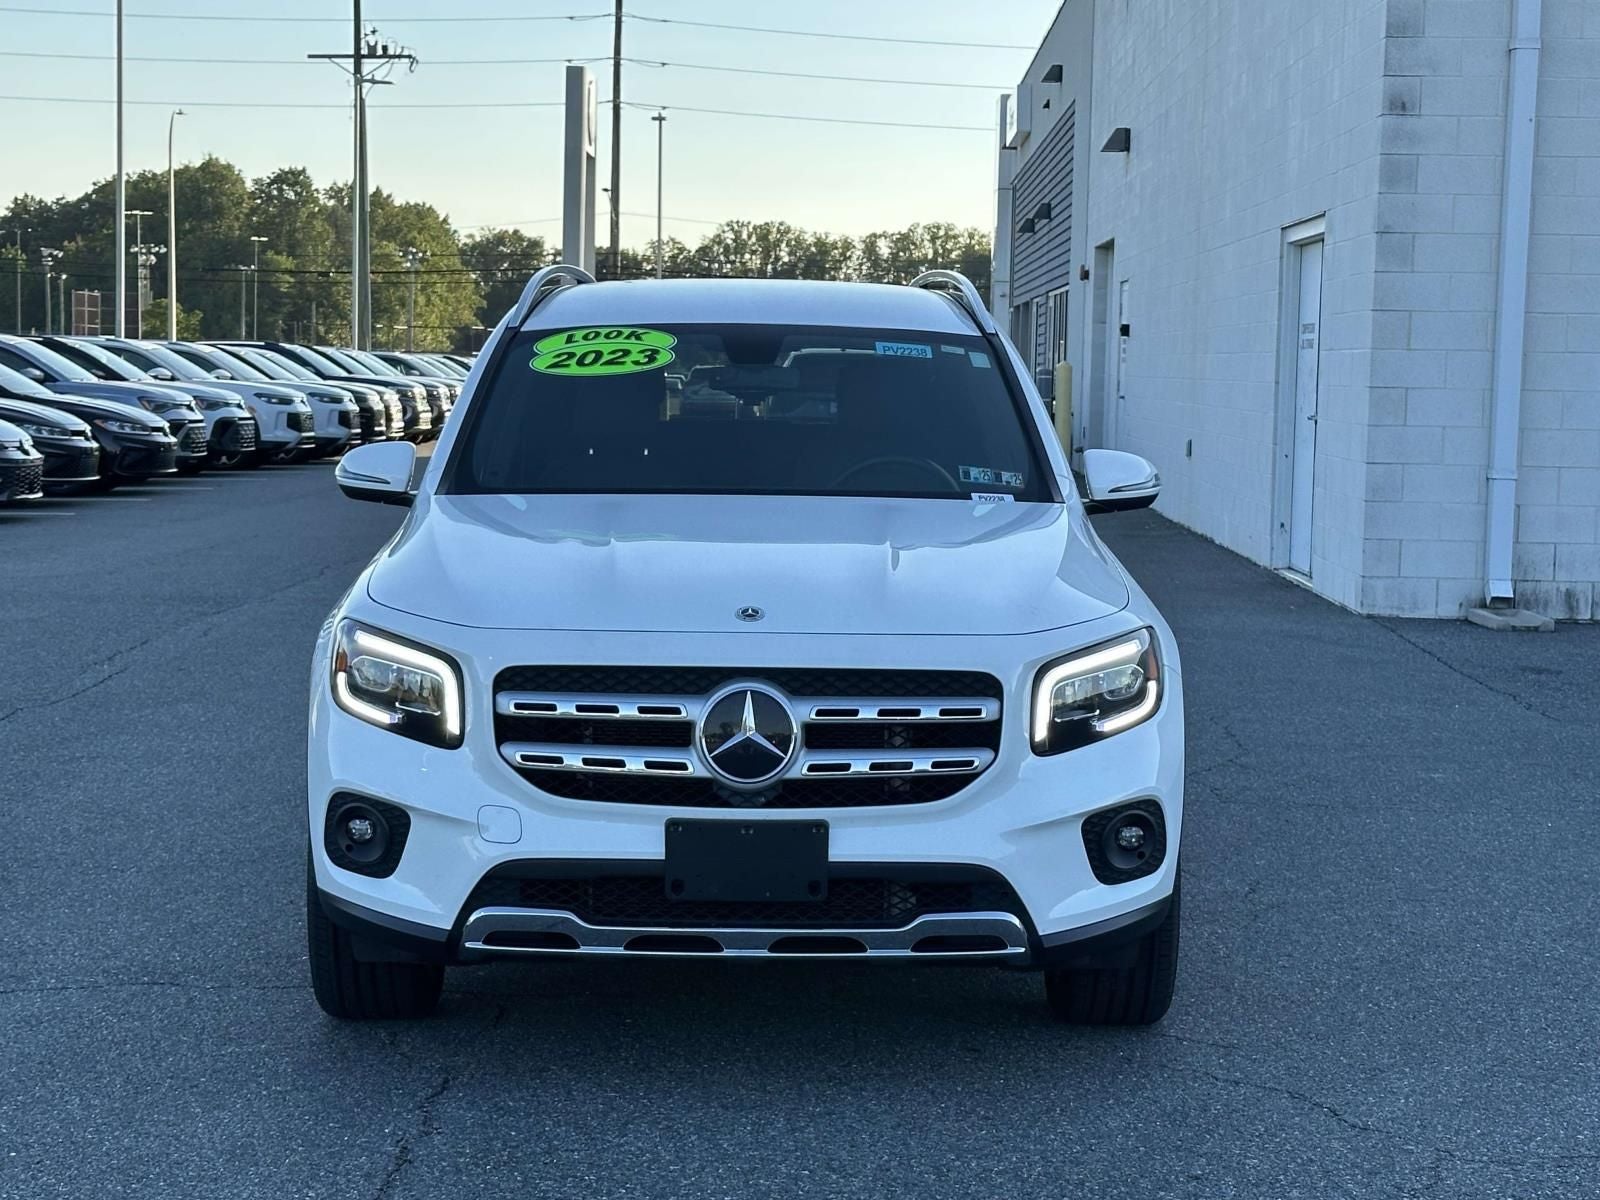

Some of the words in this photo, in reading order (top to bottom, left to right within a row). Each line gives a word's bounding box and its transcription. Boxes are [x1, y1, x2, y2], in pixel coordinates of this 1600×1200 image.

[564, 329, 652, 345] LOOK
[544, 348, 661, 370] 2023
[881, 345, 928, 357] PV2238
